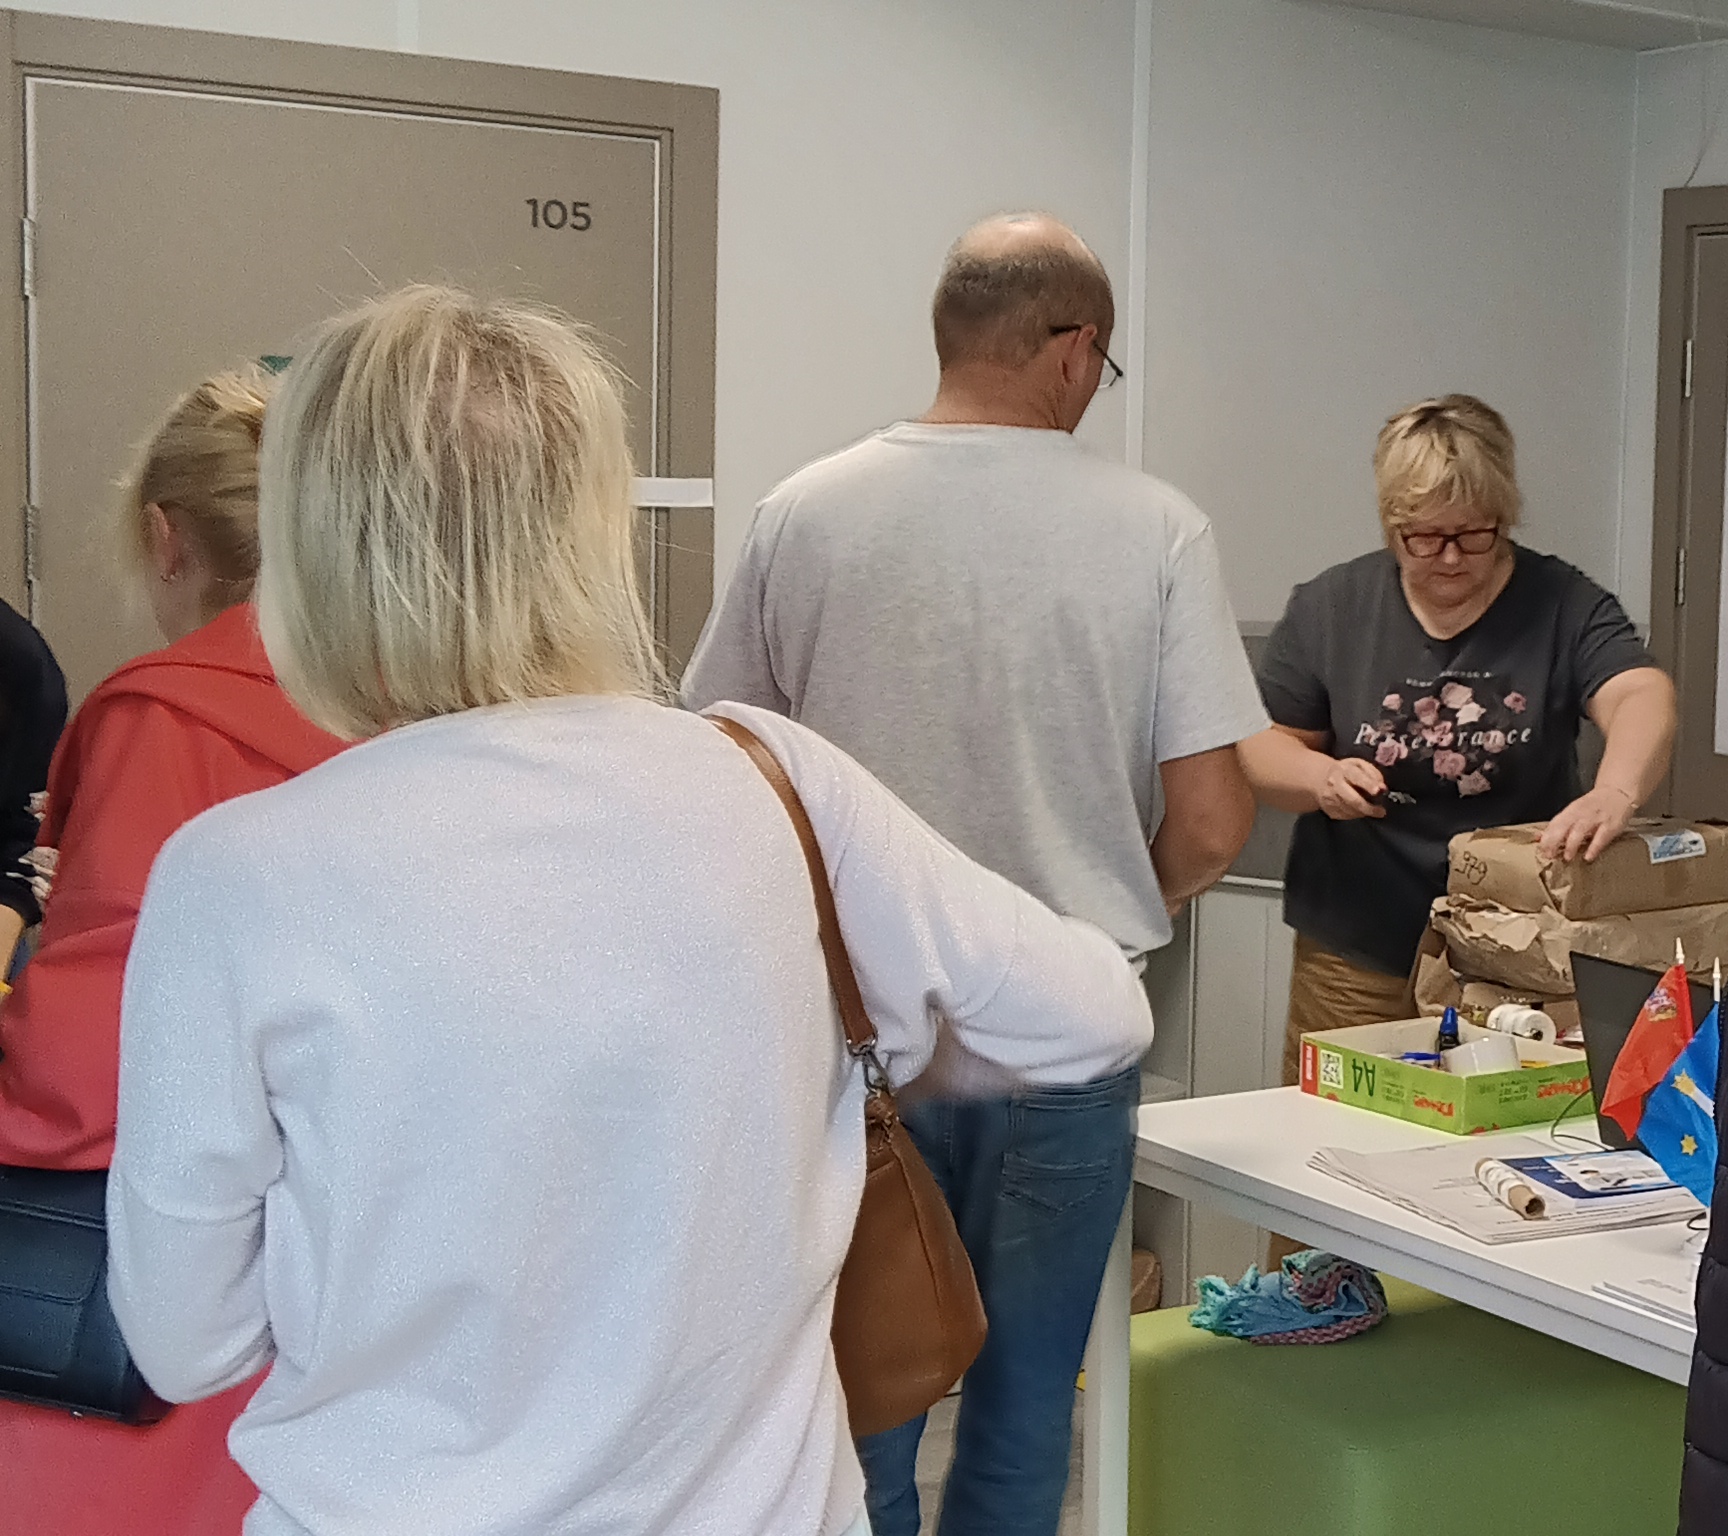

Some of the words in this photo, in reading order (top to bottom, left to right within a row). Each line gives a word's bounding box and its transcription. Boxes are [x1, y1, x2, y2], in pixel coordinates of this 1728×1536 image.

[525, 198, 592, 231] 105
[1353, 722, 1532, 750] Perserance
[1351, 1058, 1376, 1097] A4
